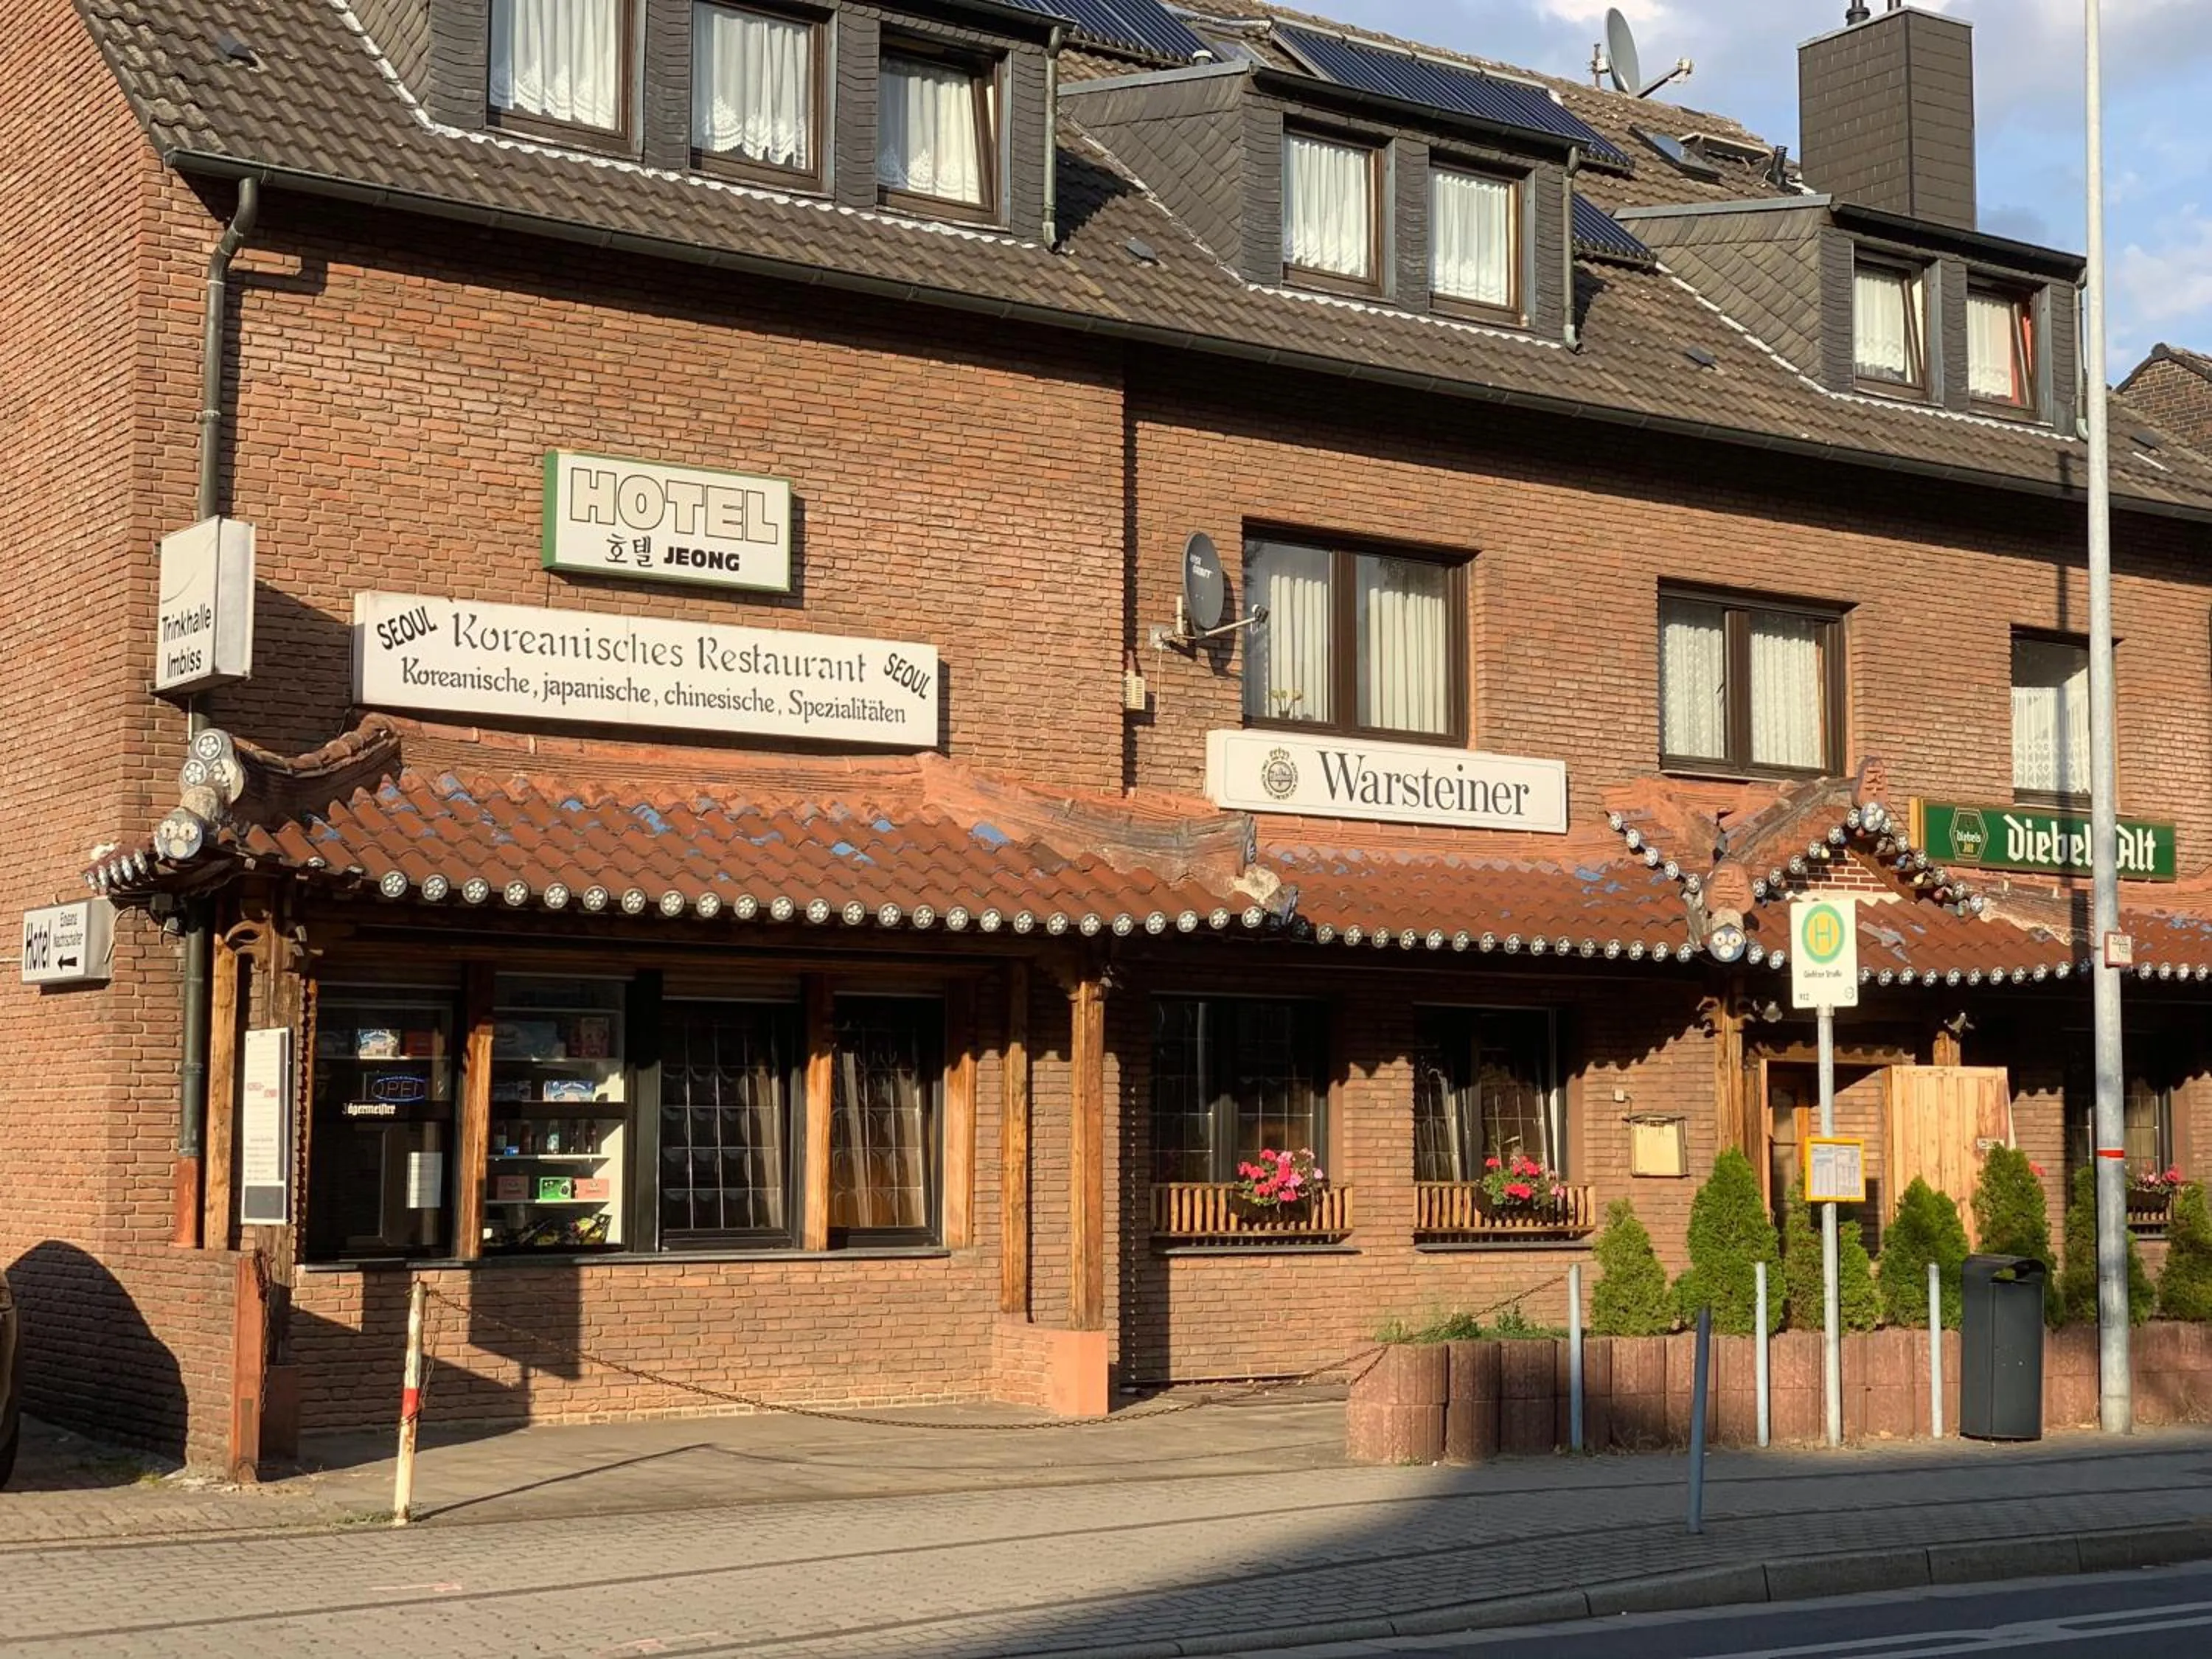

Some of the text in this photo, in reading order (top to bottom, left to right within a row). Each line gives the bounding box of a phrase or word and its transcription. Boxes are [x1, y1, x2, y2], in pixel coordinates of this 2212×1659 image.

[570, 467, 778, 545] HOTEL
[605, 533, 653, 568] 호텔
[664, 546, 740, 571] JEONG
[161, 603, 212, 643] Trinkhalle
[376, 605, 439, 651] SEOUL
[451, 611, 867, 683] Koreanisches Restaurant
[167, 648, 203, 679] Imbiss
[883, 652, 932, 700] SEOUL
[400, 655, 538, 698] Koreanische,
[541, 672, 658, 708] japanische,
[787, 689, 907, 723] Spezialitäten
[1316, 750, 1530, 816] Warsteiner
[2003, 813, 2157, 872] Diebel Alt
[25, 919, 52, 972] Hotel
[1813, 917, 1832, 951] H
